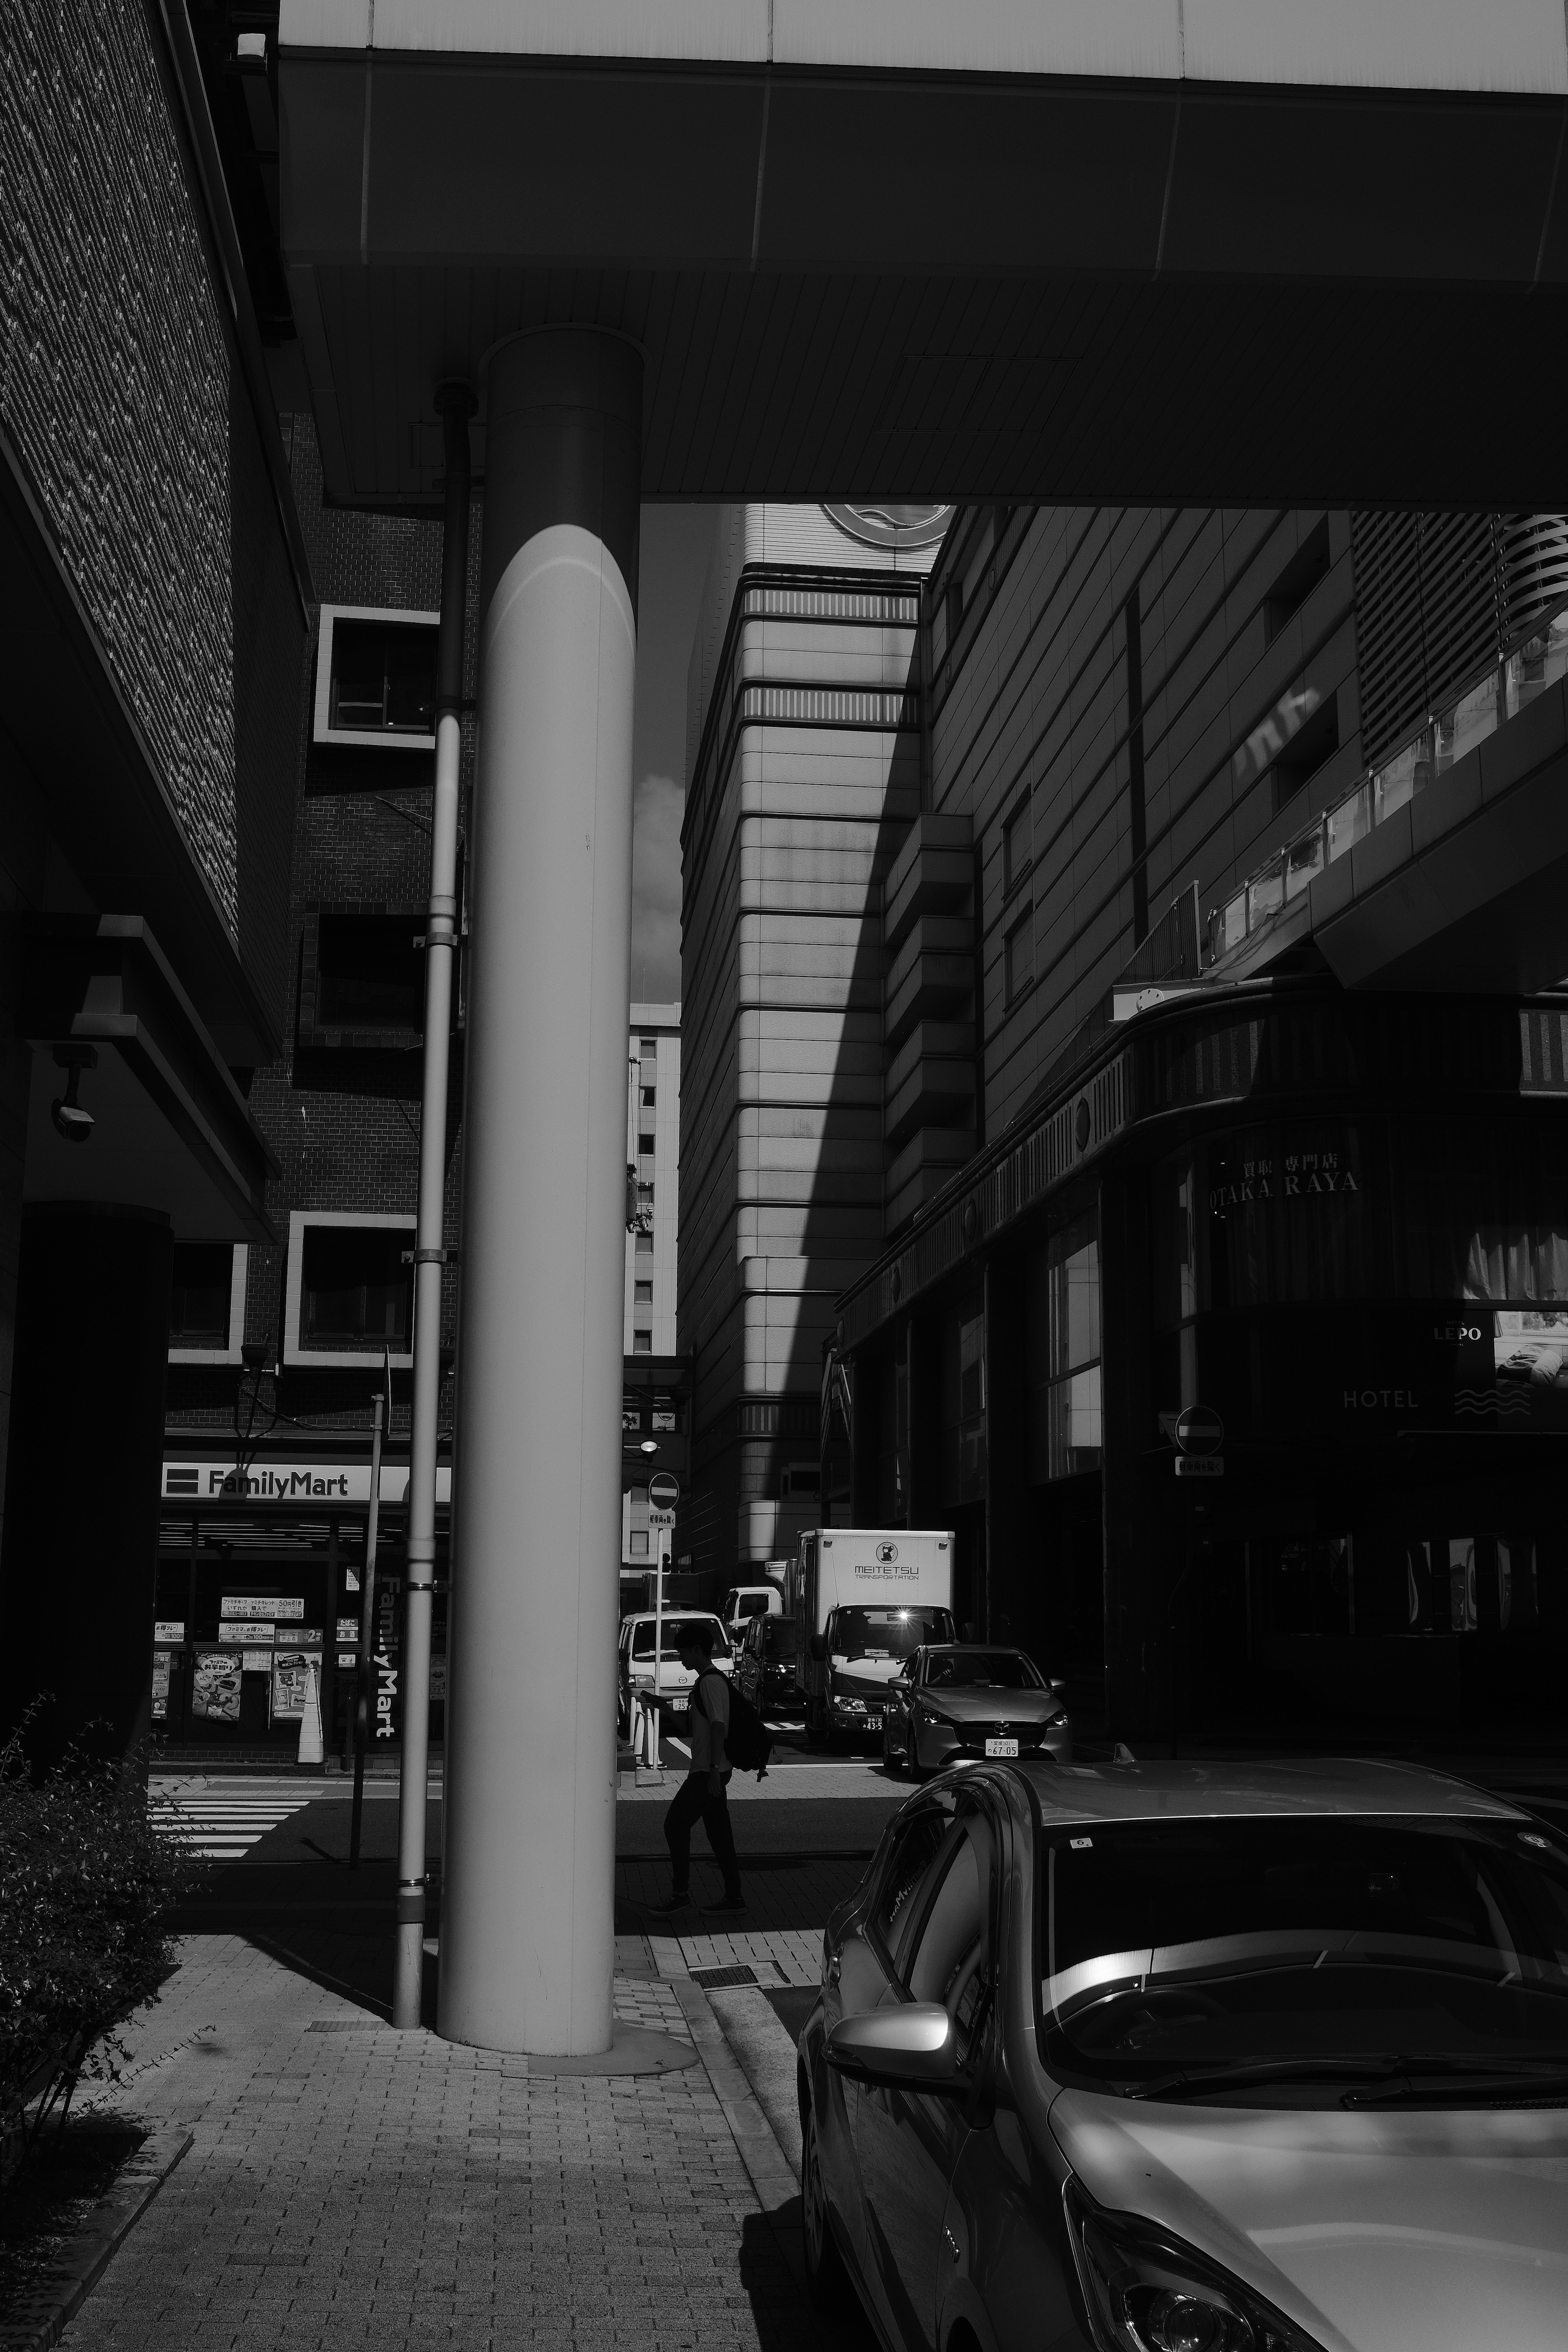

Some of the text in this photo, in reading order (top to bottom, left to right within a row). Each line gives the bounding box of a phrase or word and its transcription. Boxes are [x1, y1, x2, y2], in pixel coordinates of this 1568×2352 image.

[1244, 1153, 1338, 1179] 買取 専門店
[1283, 1171, 1360, 1195] RAYA
[1434, 1328, 1482, 1341] LEPO
[1344, 1391, 1418, 1408] HOTEL
[1179, 1461, 1220, 1472] 軽車両を除く
[209, 1470, 348, 1499] FamilyMart
[650, 1515, 674, 1524] 軽車両を除く
[855, 1566, 919, 1574] MEITETSU
[374, 1577, 401, 1737] FamilyMart
[993, 1746, 1016, 1755] 67-05
